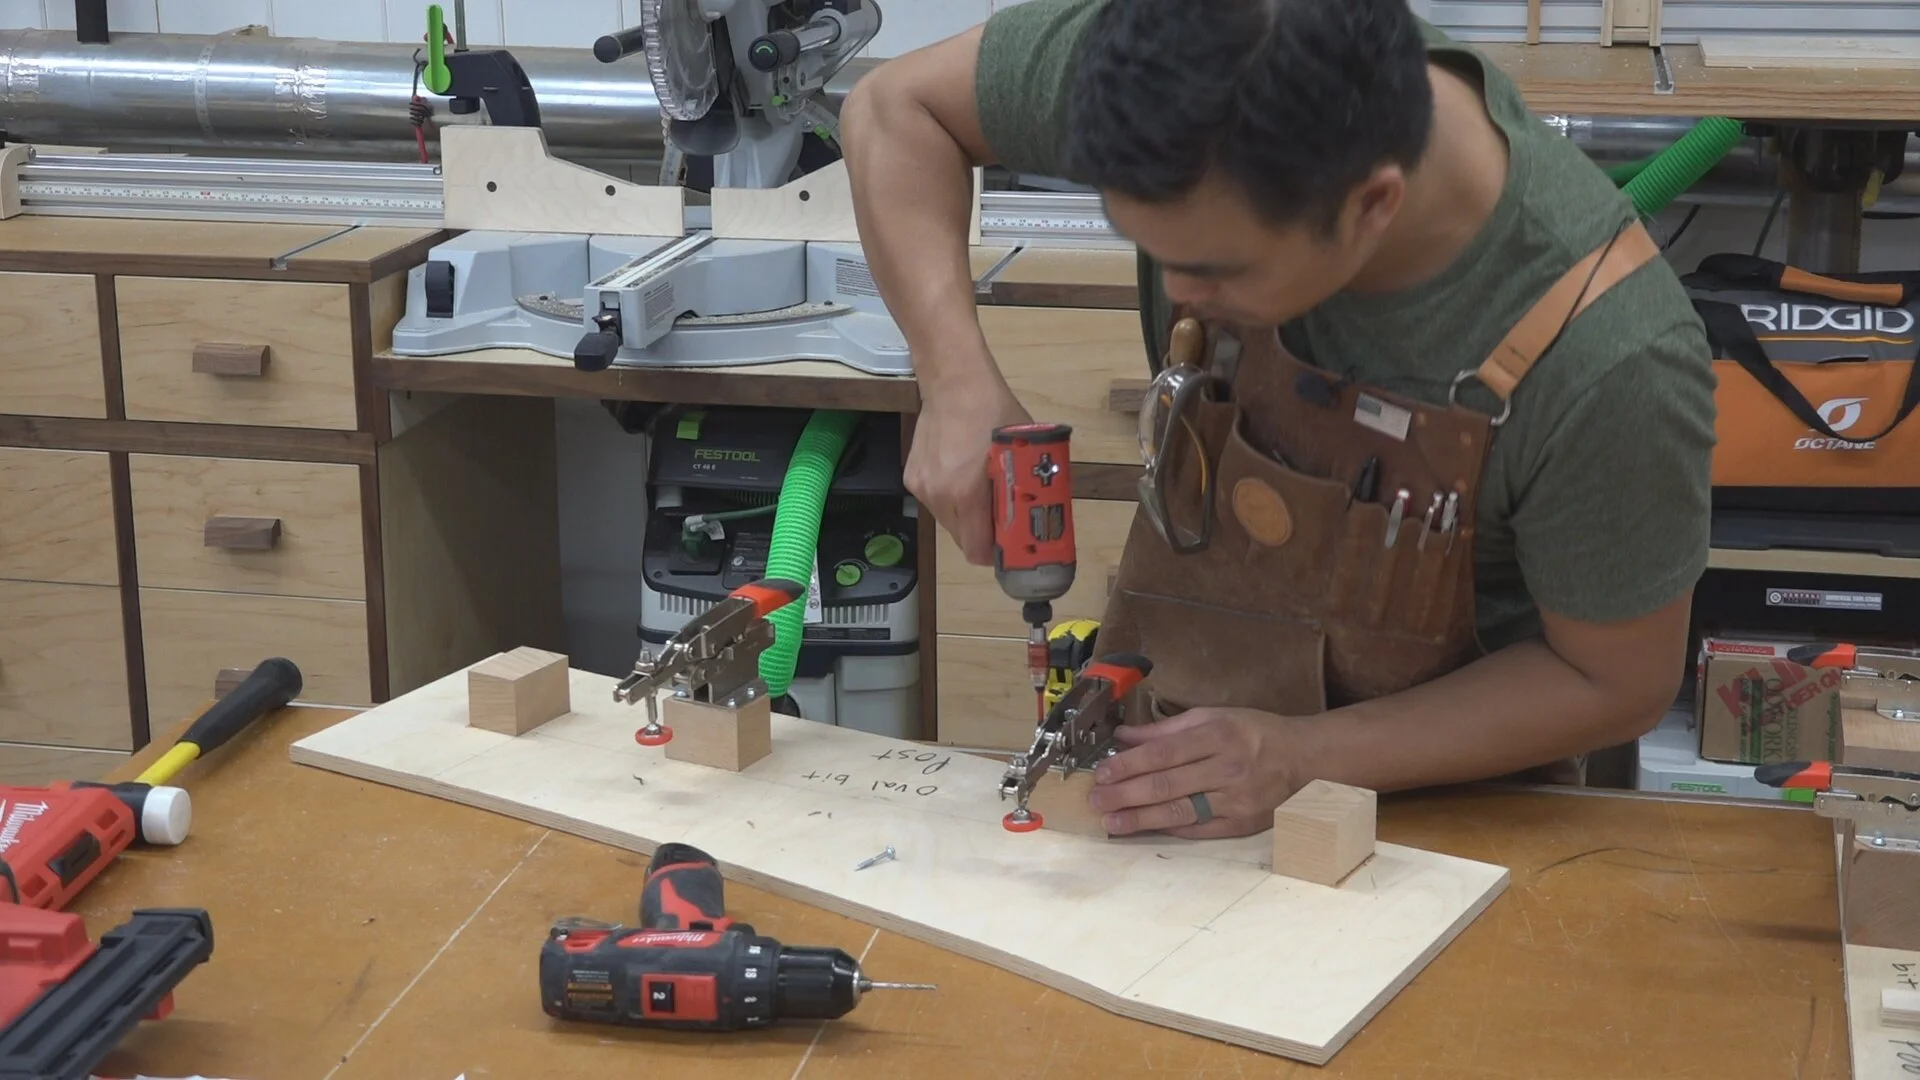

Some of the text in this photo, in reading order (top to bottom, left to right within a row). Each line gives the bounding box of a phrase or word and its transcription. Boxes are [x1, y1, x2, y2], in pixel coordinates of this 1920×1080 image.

[1740, 302, 1915, 334] RIDGID
[1793, 437, 1876, 450] OCTANE
[694, 448, 761, 463] FESTOOL
[870, 749, 951, 775] Post
[802, 770, 938, 796] Oval bit
[1671, 782, 1728, 794] FESTOOL
[632, 932, 706, 945] Milwaukee
[1891, 962, 1919, 990] bit
[653, 991, 666, 1001] 2
